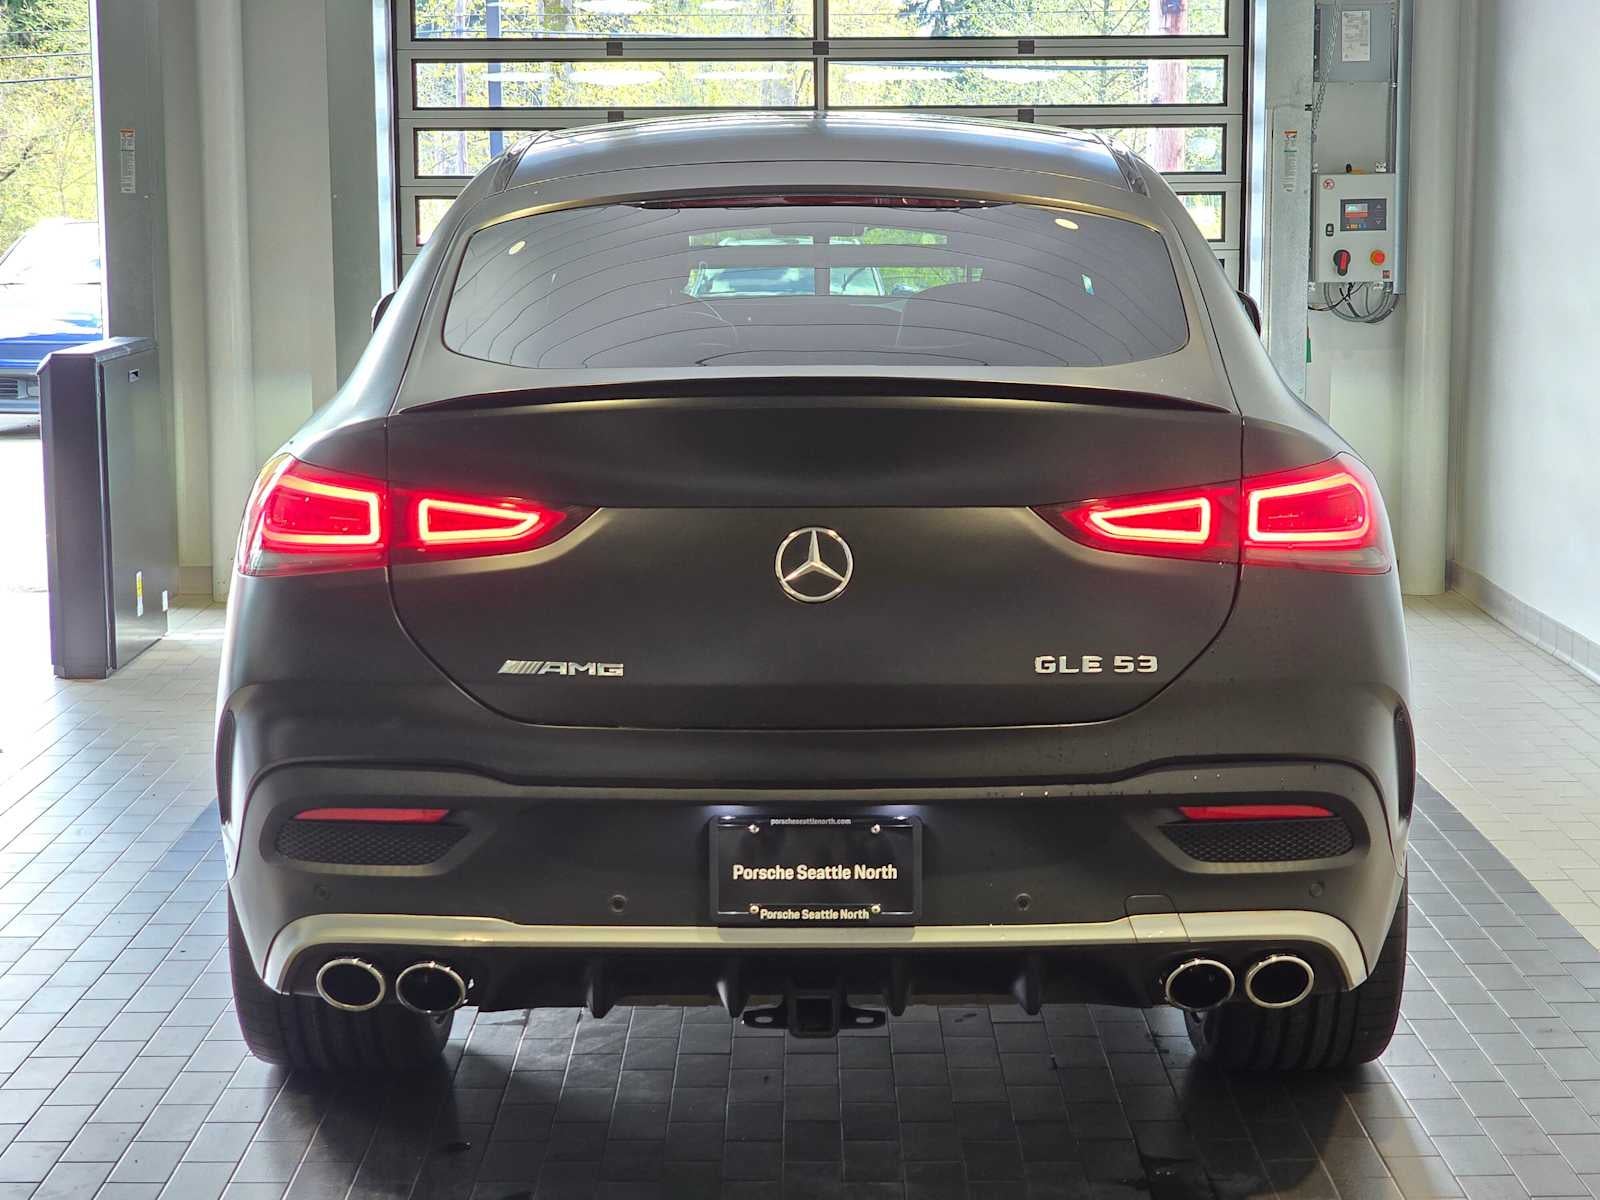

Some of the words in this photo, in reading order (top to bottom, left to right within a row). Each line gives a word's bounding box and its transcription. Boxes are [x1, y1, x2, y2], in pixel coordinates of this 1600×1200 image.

[537, 661, 624, 677] AMG
[1034, 655, 1103, 674] GLE
[1113, 655, 1158, 673] 53
[770, 818, 851, 826] porscheseattlenorth.com
[732, 864, 794, 880] Porsche
[796, 864, 851, 880] Seattle
[854, 864, 898, 880] North
[760, 908, 800, 920] Porsche
[801, 908, 839, 920] Seattle
[840, 908, 870, 920] North
